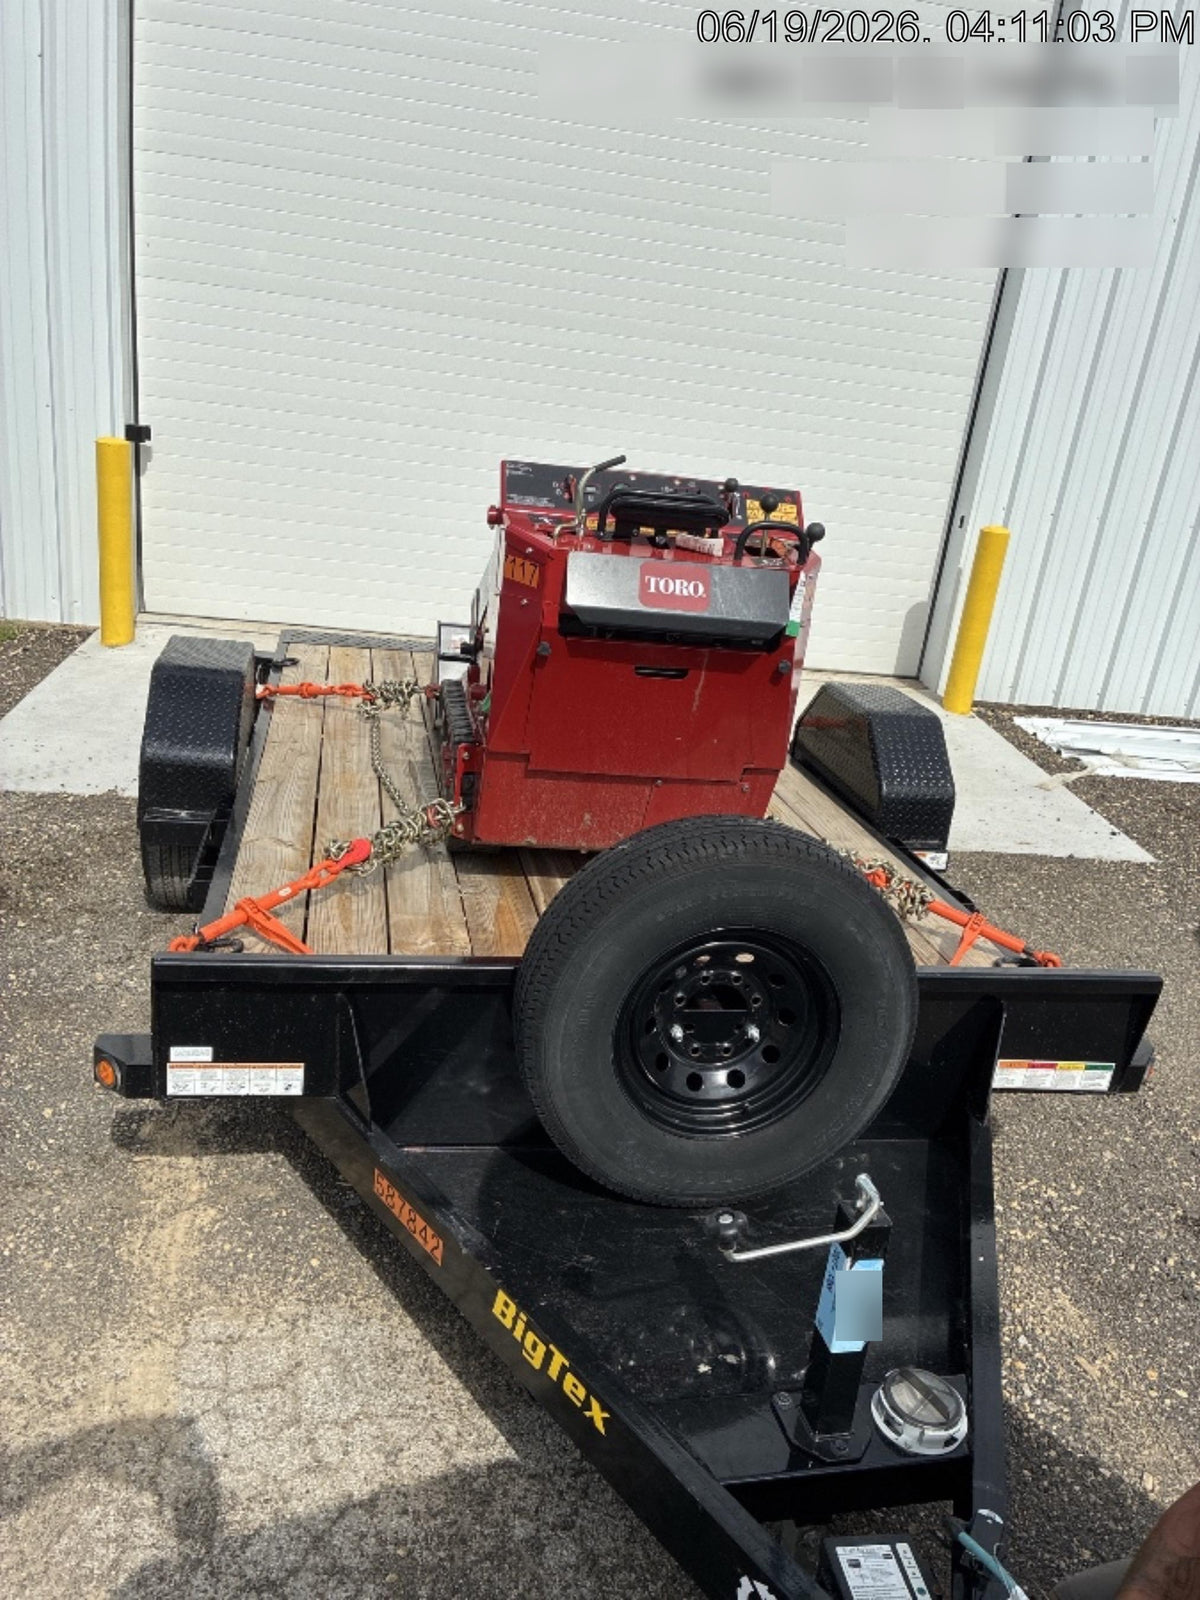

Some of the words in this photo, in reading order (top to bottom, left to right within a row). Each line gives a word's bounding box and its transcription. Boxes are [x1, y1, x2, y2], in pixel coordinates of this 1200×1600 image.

[645, 575, 705, 598] TORO
[376, 1172, 440, 1261] 587842
[492, 1288, 611, 1436] BigTex
